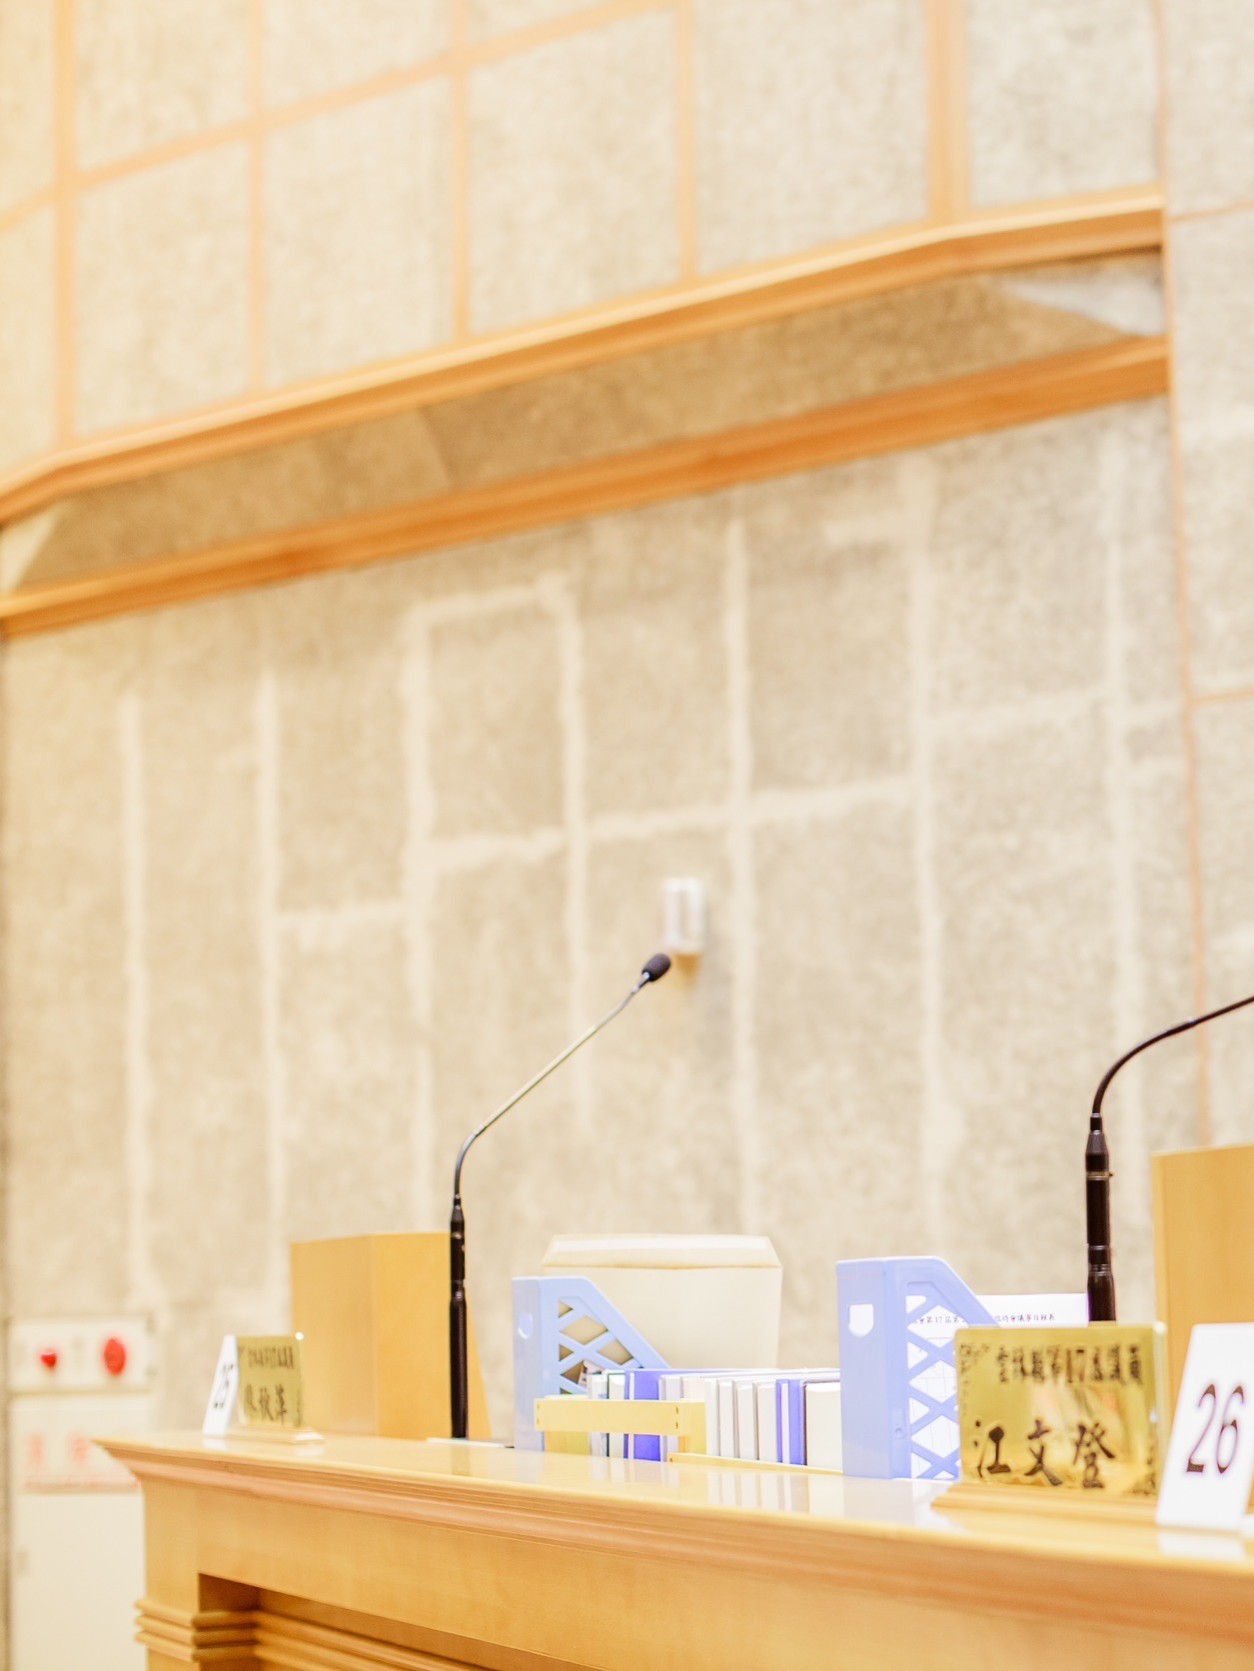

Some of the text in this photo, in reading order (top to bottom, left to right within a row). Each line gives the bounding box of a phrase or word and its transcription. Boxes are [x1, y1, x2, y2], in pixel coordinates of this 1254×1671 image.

[974, 1420, 1116, 1488] 江文登
[1186, 1384, 1244, 1474] 26
